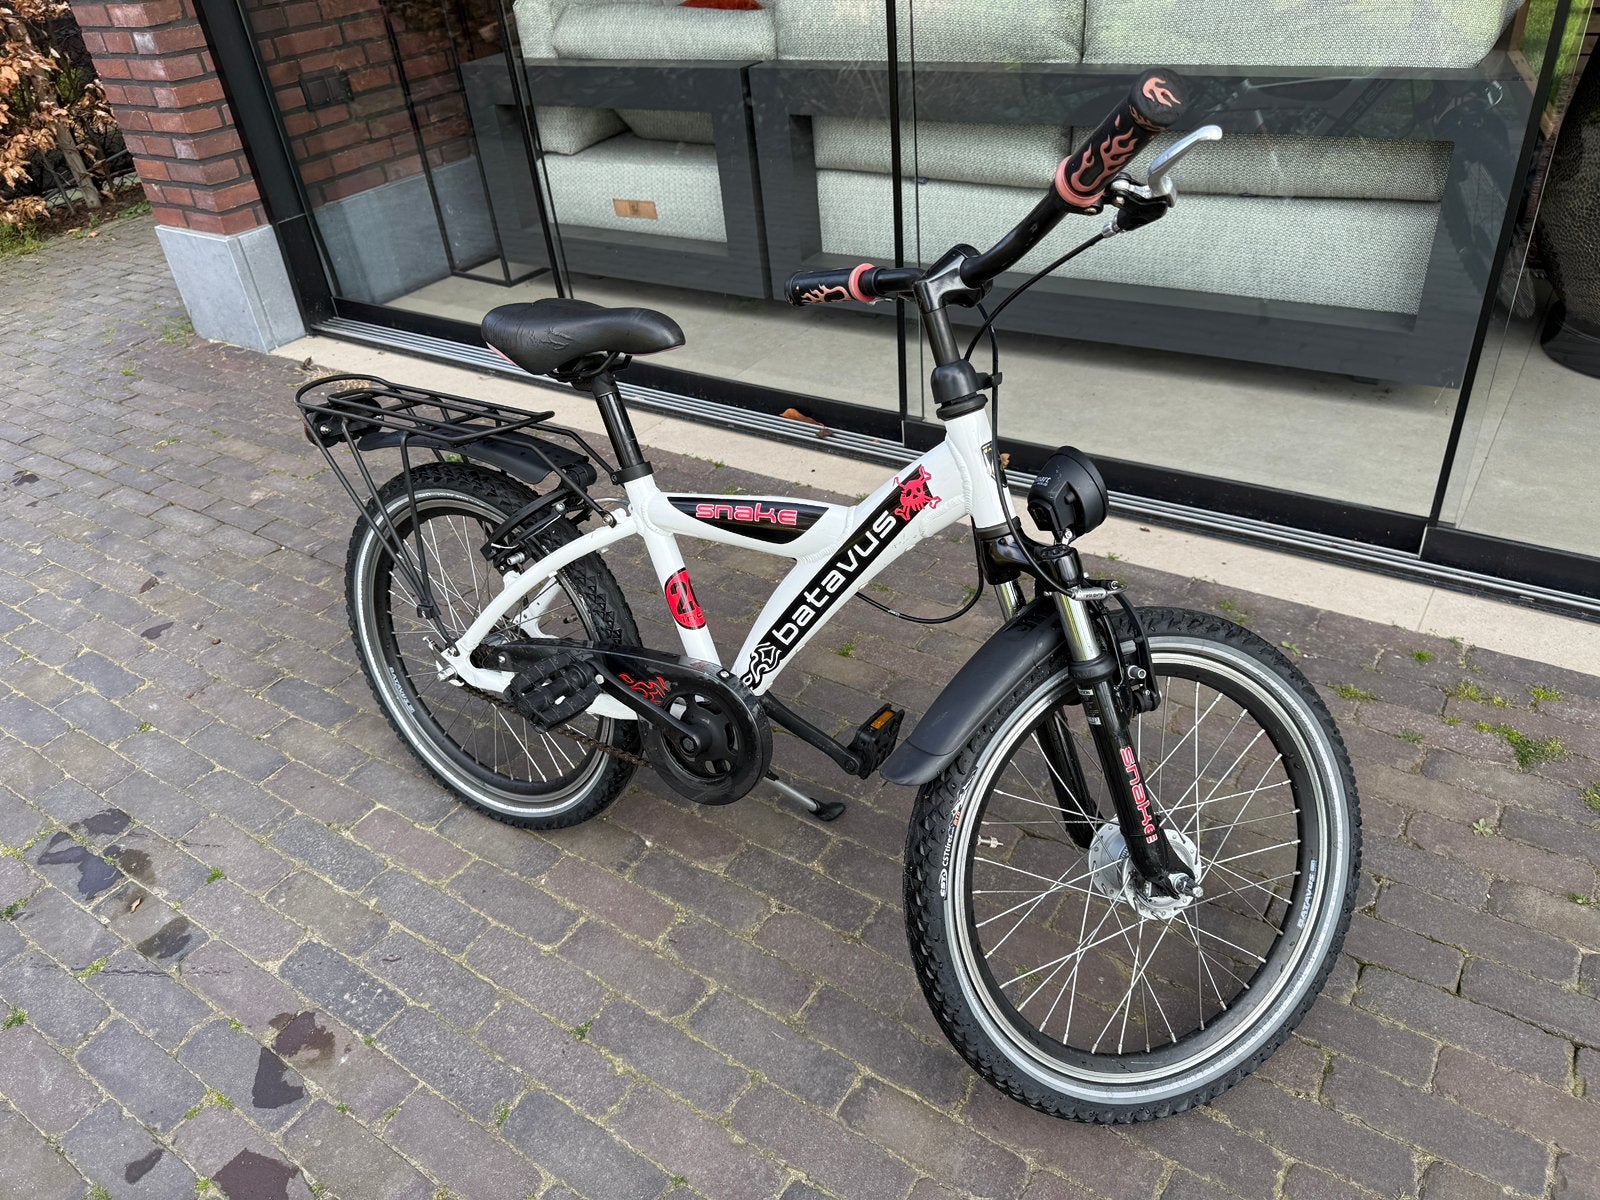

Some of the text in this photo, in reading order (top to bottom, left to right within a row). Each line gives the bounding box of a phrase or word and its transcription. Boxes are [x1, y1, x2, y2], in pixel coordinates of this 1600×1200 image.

[695, 502, 798, 526] snake
[772, 509, 897, 647] batavus
[1120, 746, 1158, 844] snake
